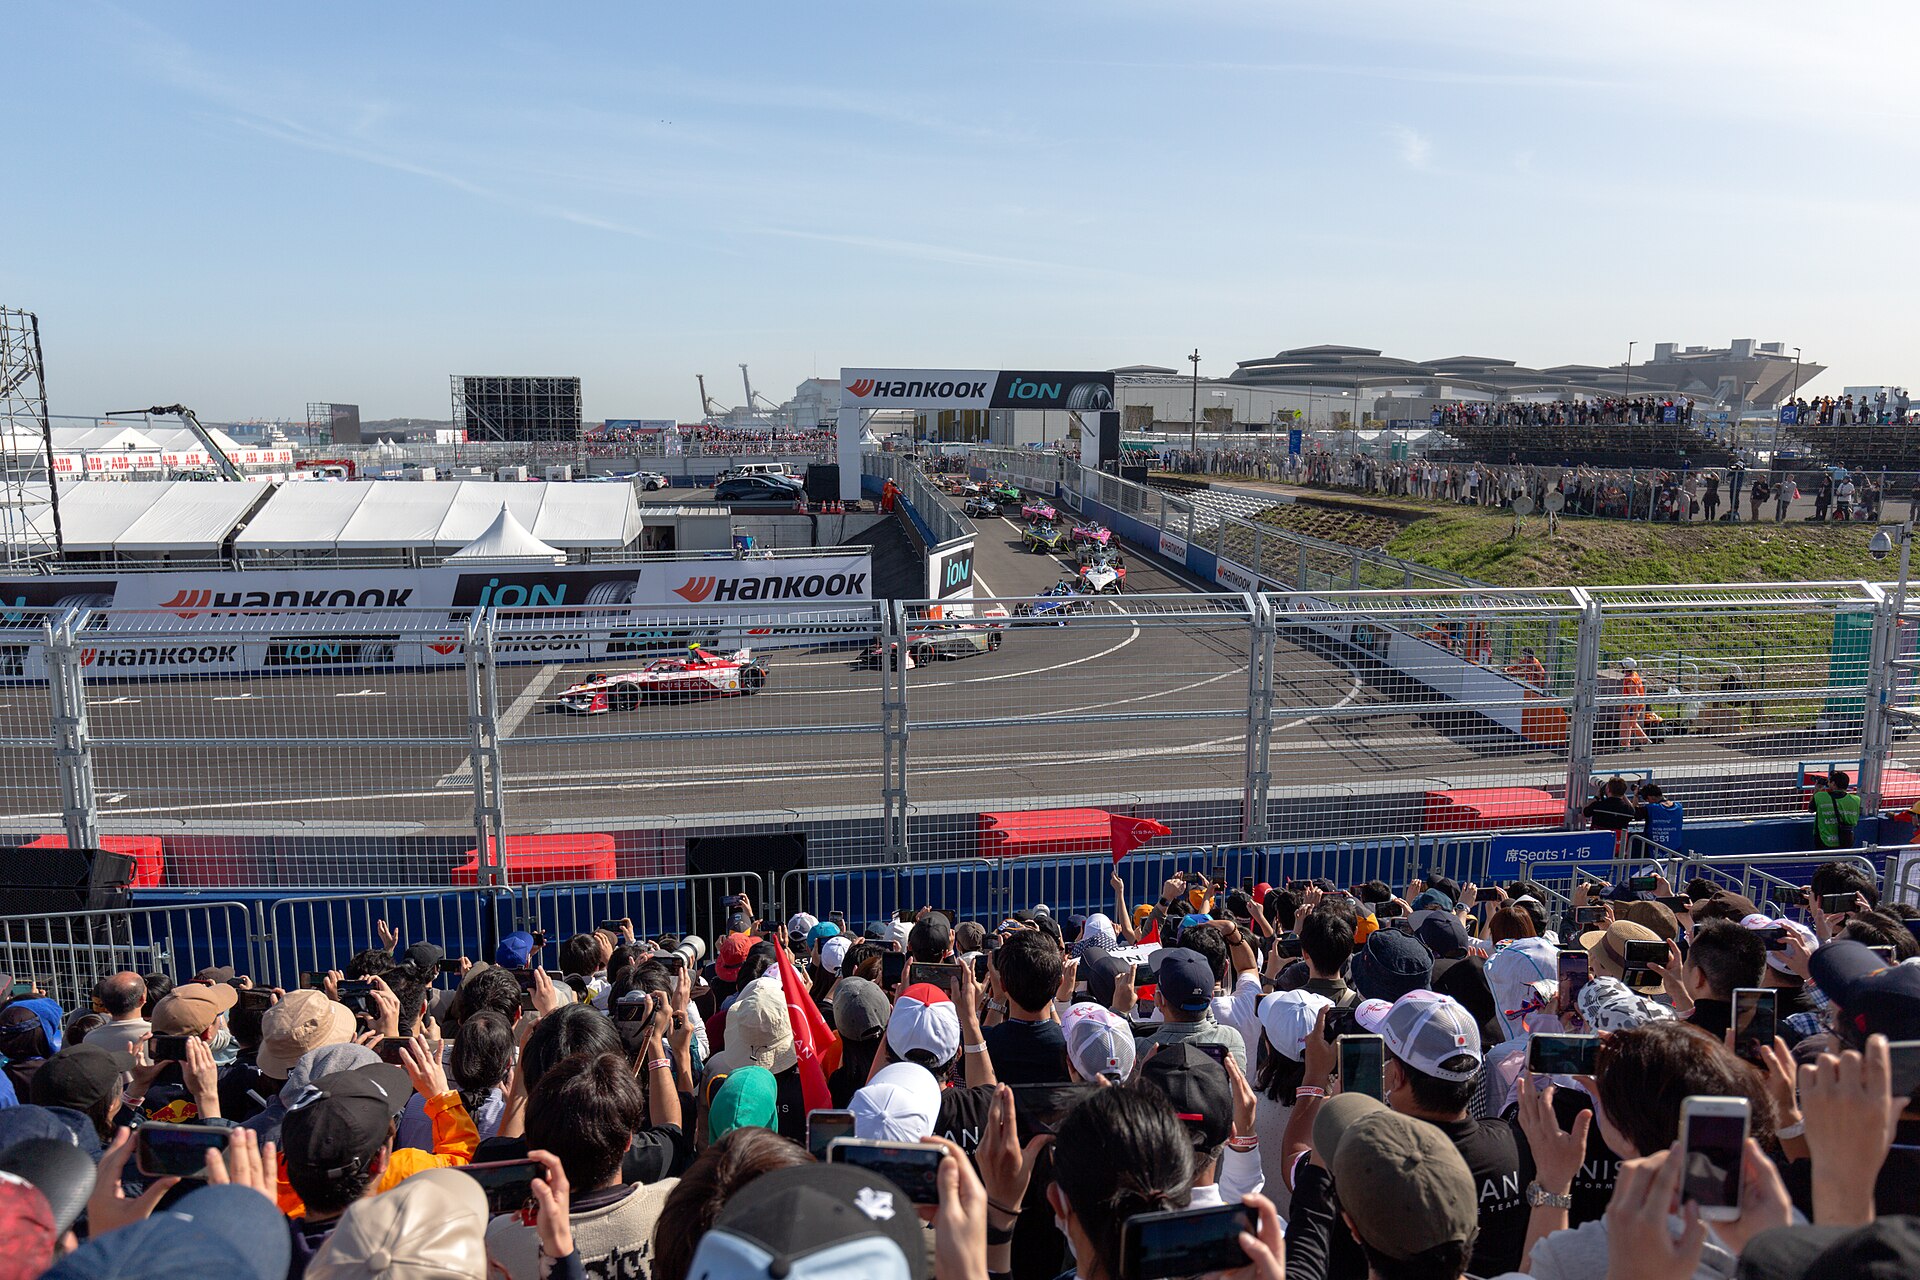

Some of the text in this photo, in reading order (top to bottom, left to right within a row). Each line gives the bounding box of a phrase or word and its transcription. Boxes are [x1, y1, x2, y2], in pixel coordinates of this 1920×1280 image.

[1664, 410, 1676, 419] 22
[1783, 411, 1795, 420] 21
[137, 456, 154, 468] ABB
[163, 455, 178, 467] ABB
[185, 454, 200, 465] ABB
[246, 452, 257, 463] ABB
[263, 452, 274, 462] ABB
[53, 458, 72, 471] ABB
[111, 457, 129, 469] ABB
[660, 680, 711, 689] NISSAN
[1577, 847, 1591, 858] 15
[1489, 1199, 1520, 1213] TEAM
